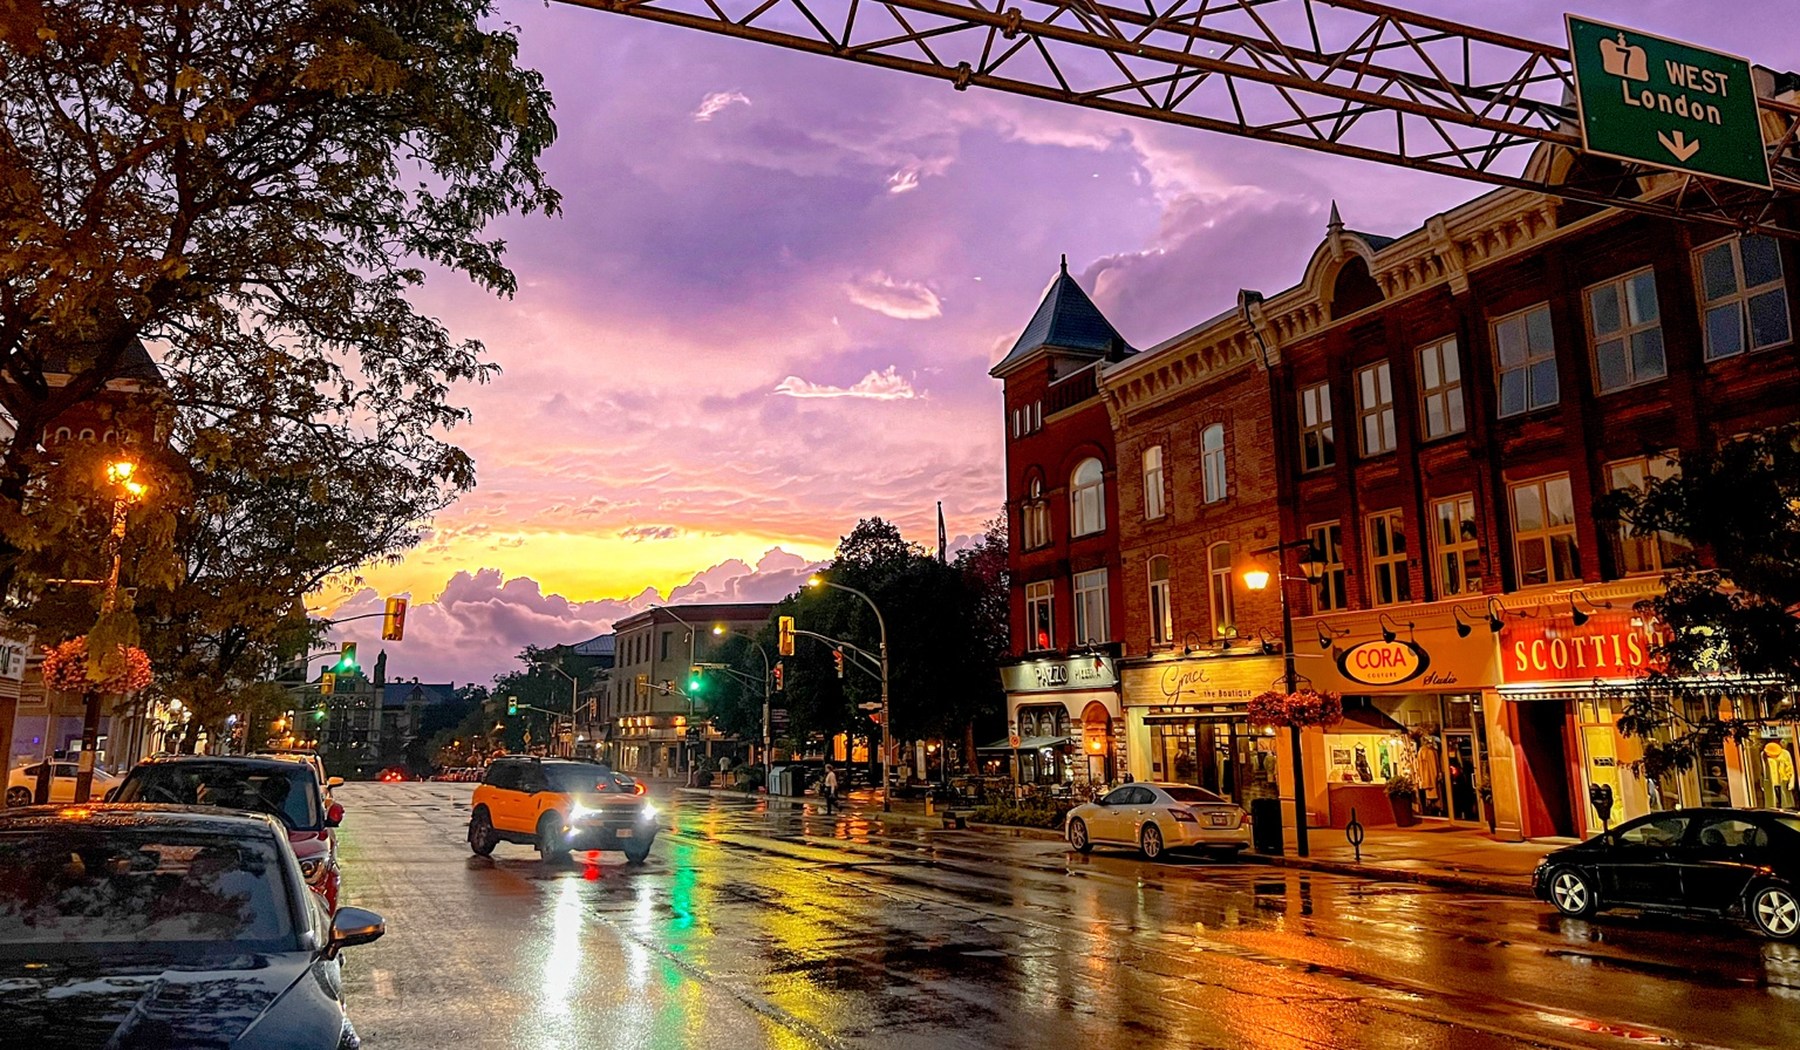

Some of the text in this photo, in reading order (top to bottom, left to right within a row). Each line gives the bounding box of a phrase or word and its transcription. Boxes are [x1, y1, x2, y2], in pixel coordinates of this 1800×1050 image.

[1616, 47, 1728, 97] 7 WEST
[1622, 79, 1721, 125] London
[1355, 647, 1407, 670] CORA
[1035, 664, 1069, 686] PAZZO
[1161, 664, 1210, 705] Grace
[1422, 670, 1458, 687] Studio
[1203, 689, 1252, 699] the Boutique
